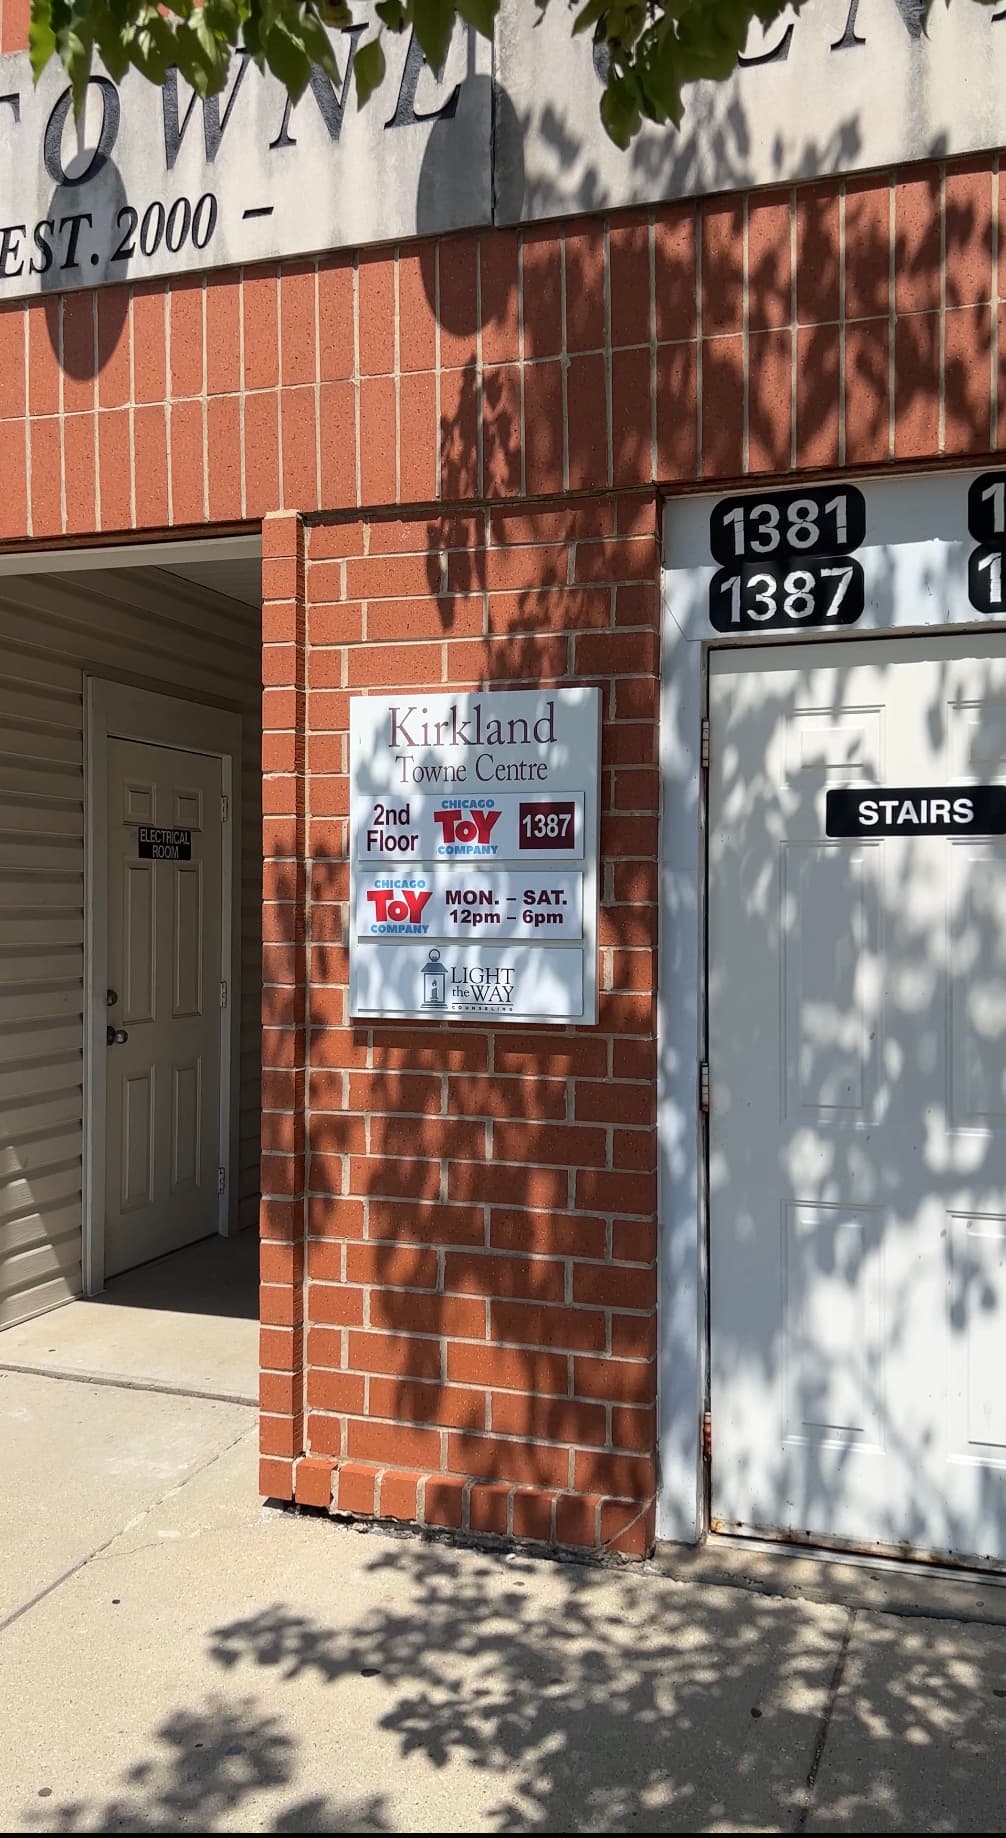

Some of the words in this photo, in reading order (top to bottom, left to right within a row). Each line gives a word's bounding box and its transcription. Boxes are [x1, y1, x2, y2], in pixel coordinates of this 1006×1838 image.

[0, 212, 99, 279] EST.
[110, 193, 218, 262] 2000
[722, 495, 848, 556] 1381
[720, 566, 853, 623] 1387
[388, 701, 558, 748] Kirkland
[395, 755, 467, 783] Towne
[475, 753, 549, 782] Centre
[441, 799, 495, 809] CHICAGO
[858, 798, 974, 826] STAIRS
[373, 804, 411, 826] 2nd
[522, 813, 572, 838] 1387
[140, 828, 190, 845] ELECTRICAL
[367, 829, 419, 852] Floor
[152, 844, 179, 859] ROOM
[437, 845, 498, 855] COMPANY
[374, 879, 426, 889] CHICAGO
[445, 889, 500, 905] MON.
[523, 889, 568, 905] SAT.
[449, 909, 501, 927] 12pm
[522, 909, 564, 927] 6pm
[370, 924, 430, 934] COMPANY
[451, 966, 515, 984] LIGHT
[452, 985, 470, 997] the
[470, 984, 514, 1003] WAY
